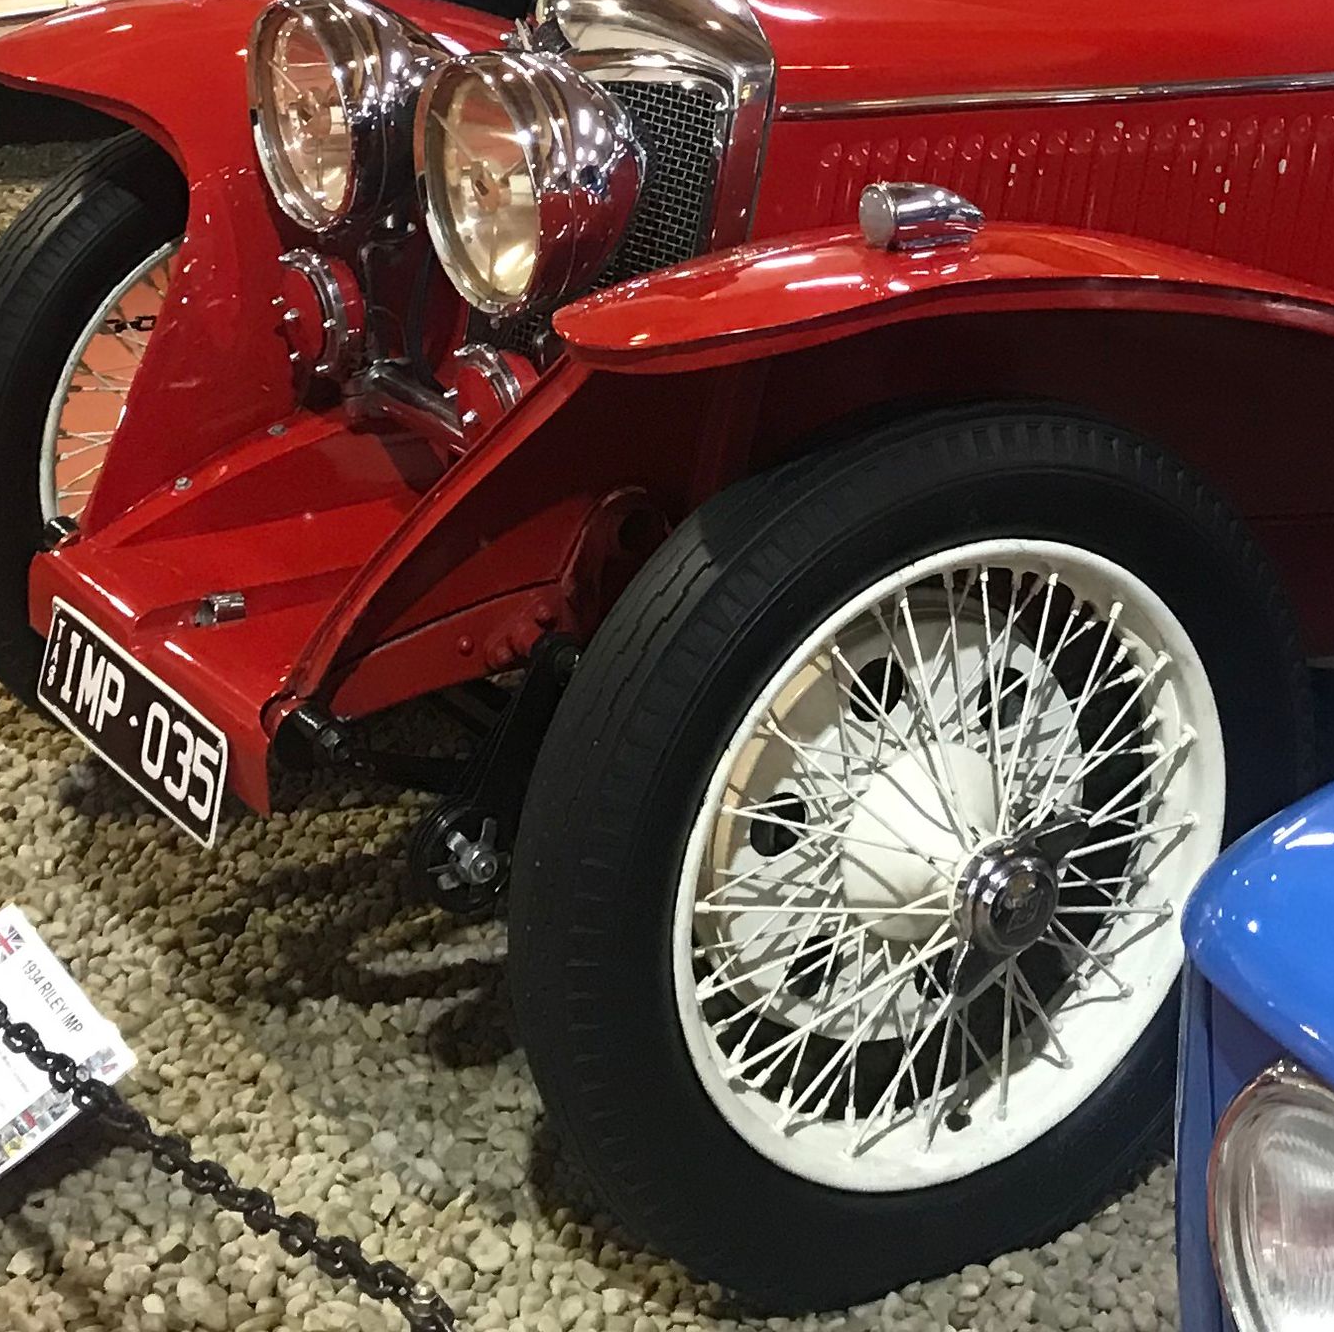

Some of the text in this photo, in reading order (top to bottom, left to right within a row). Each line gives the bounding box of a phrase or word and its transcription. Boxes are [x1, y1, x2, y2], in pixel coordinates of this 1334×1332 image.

[22, 959, 84, 1033] 1934 RILEY IMP
